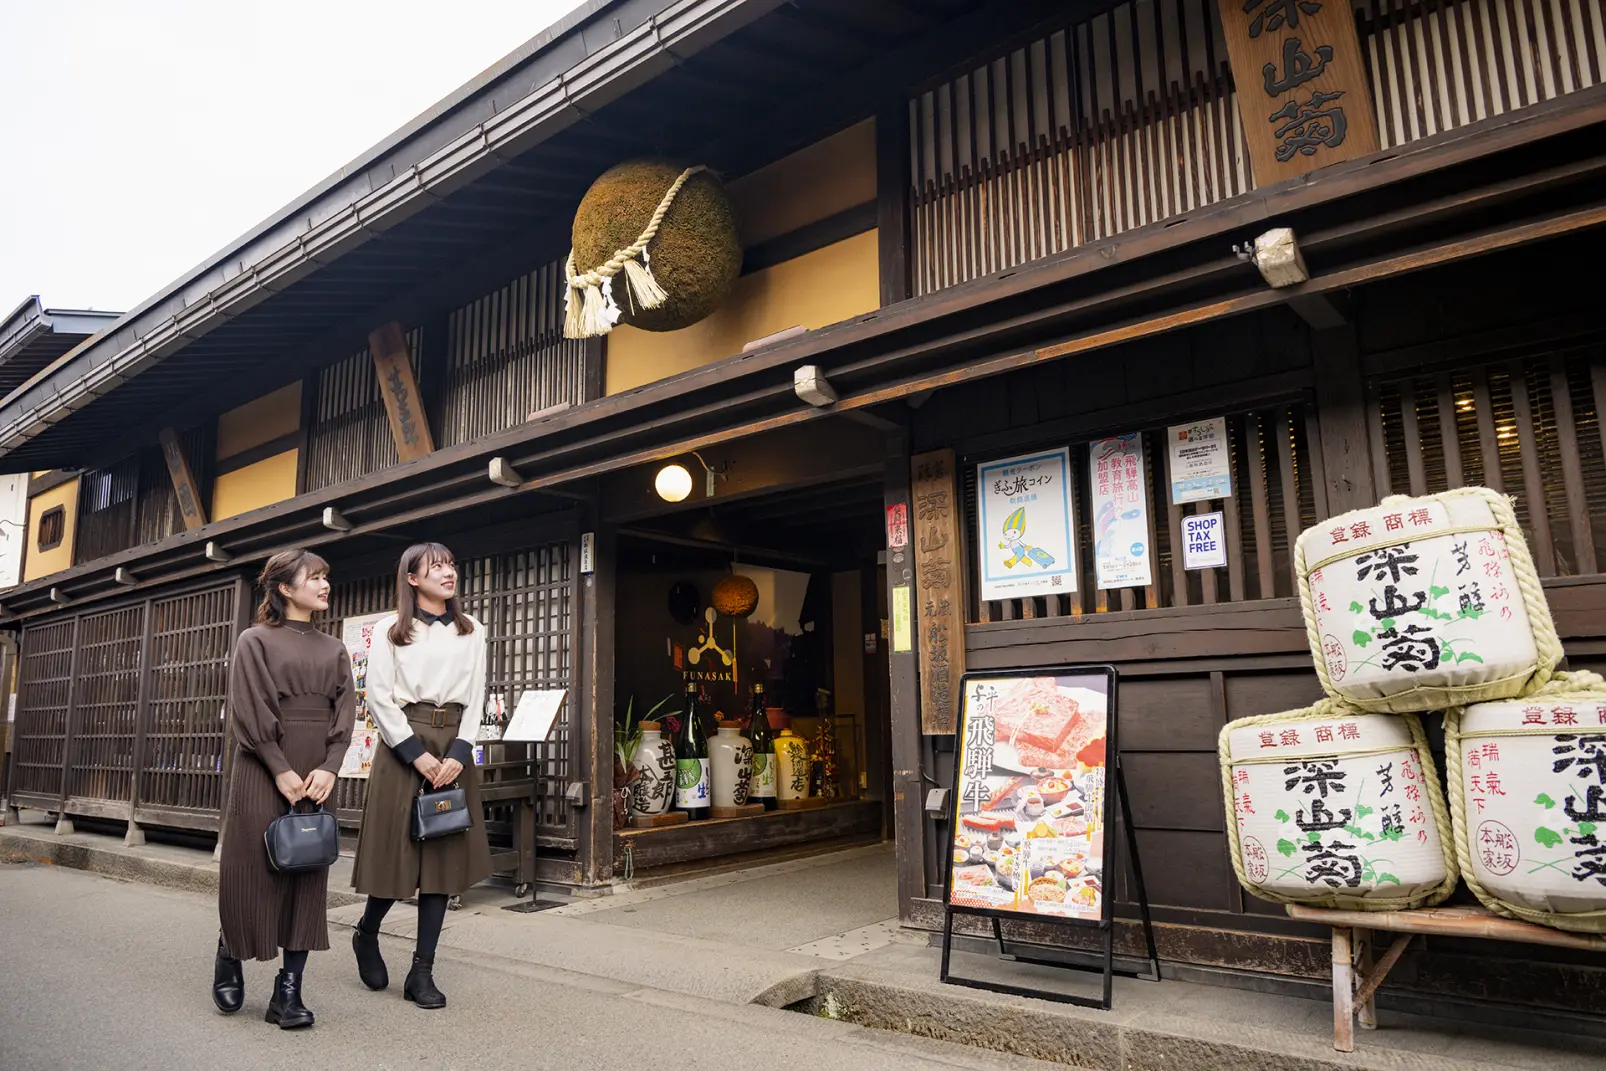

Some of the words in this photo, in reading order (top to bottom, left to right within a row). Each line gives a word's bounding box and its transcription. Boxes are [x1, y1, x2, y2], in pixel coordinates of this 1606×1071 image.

[1002, 464, 1042, 477] 観光クーポン
[1097, 461, 1109, 495] 加盟店
[1125, 454, 1139, 503] 飛騨高山
[994, 475, 1052, 496] ぎふ旅コイン
[1187, 518, 1218, 532] SHOP
[1188, 530, 1211, 541] TAX
[1189, 540, 1216, 553] FREE
[683, 671, 733, 681] FUNASAK
[963, 714, 996, 812] 飛騨牛
